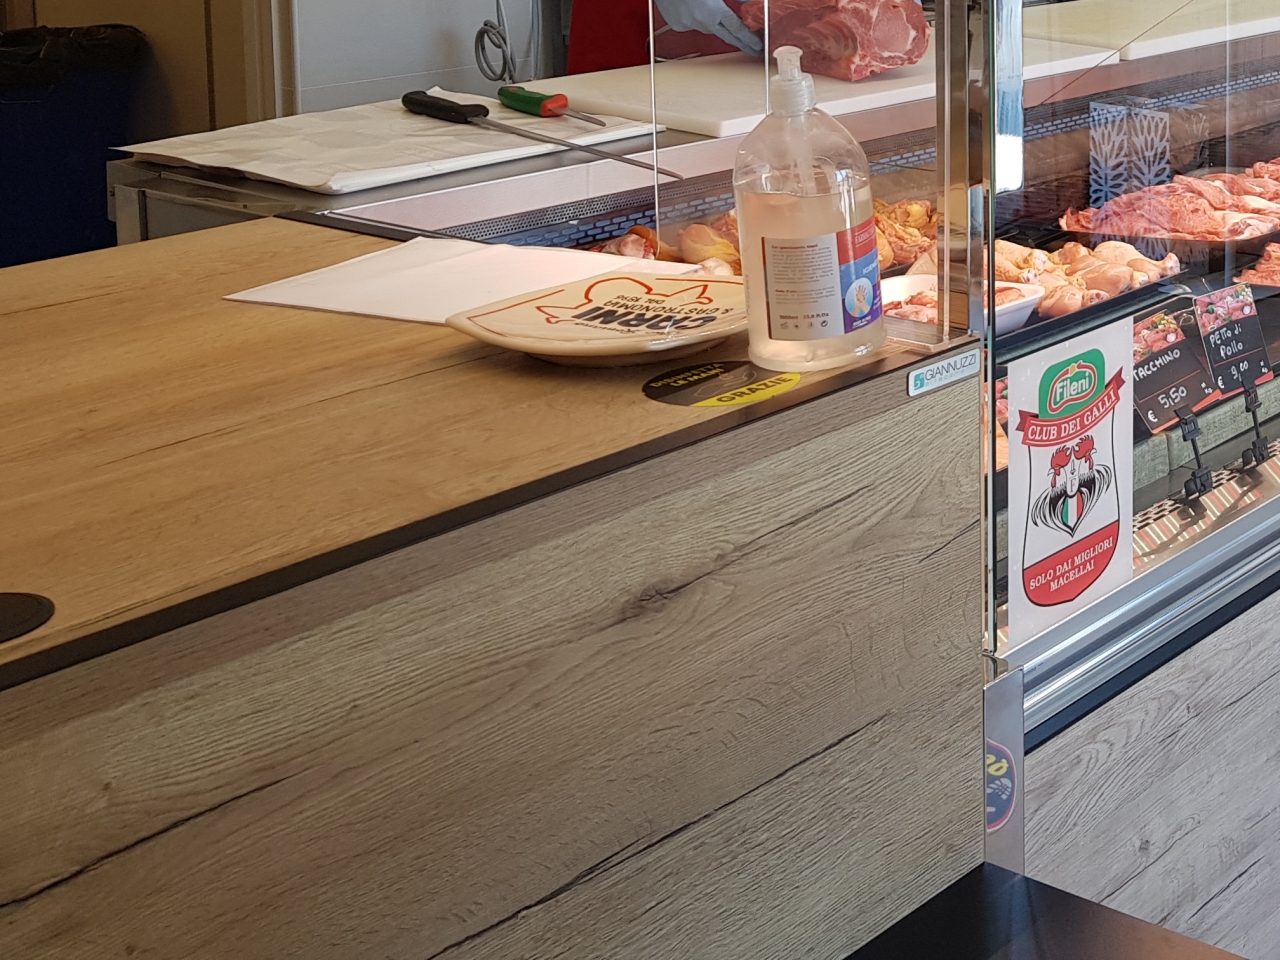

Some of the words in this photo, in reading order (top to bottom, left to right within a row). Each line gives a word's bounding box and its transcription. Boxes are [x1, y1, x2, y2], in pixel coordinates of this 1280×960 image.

[571, 306, 718, 331] CARNI
[603, 299, 721, 315] GASTRONOMIA
[1234, 323, 1242, 335] di
[649, 363, 725, 388] DISINFETTA
[669, 378, 688, 387] LE
[689, 368, 725, 383] MANI
[925, 353, 977, 381] GIANNUZZI
[1132, 348, 1181, 382] TACCHINO
[716, 376, 794, 403] GRAZIE
[1056, 371, 1089, 402] Fileni
[1158, 386, 1188, 409] 5,50
[1027, 425, 1058, 440] CLUB
[1060, 417, 1081, 437] DEI
[1084, 389, 1117, 425] GALLI
[1029, 569, 1054, 590] SOLO
[1055, 558, 1072, 576] DAI
[1073, 536, 1114, 566] MIGLIORI
[1049, 559, 1095, 592] MACELLAI
